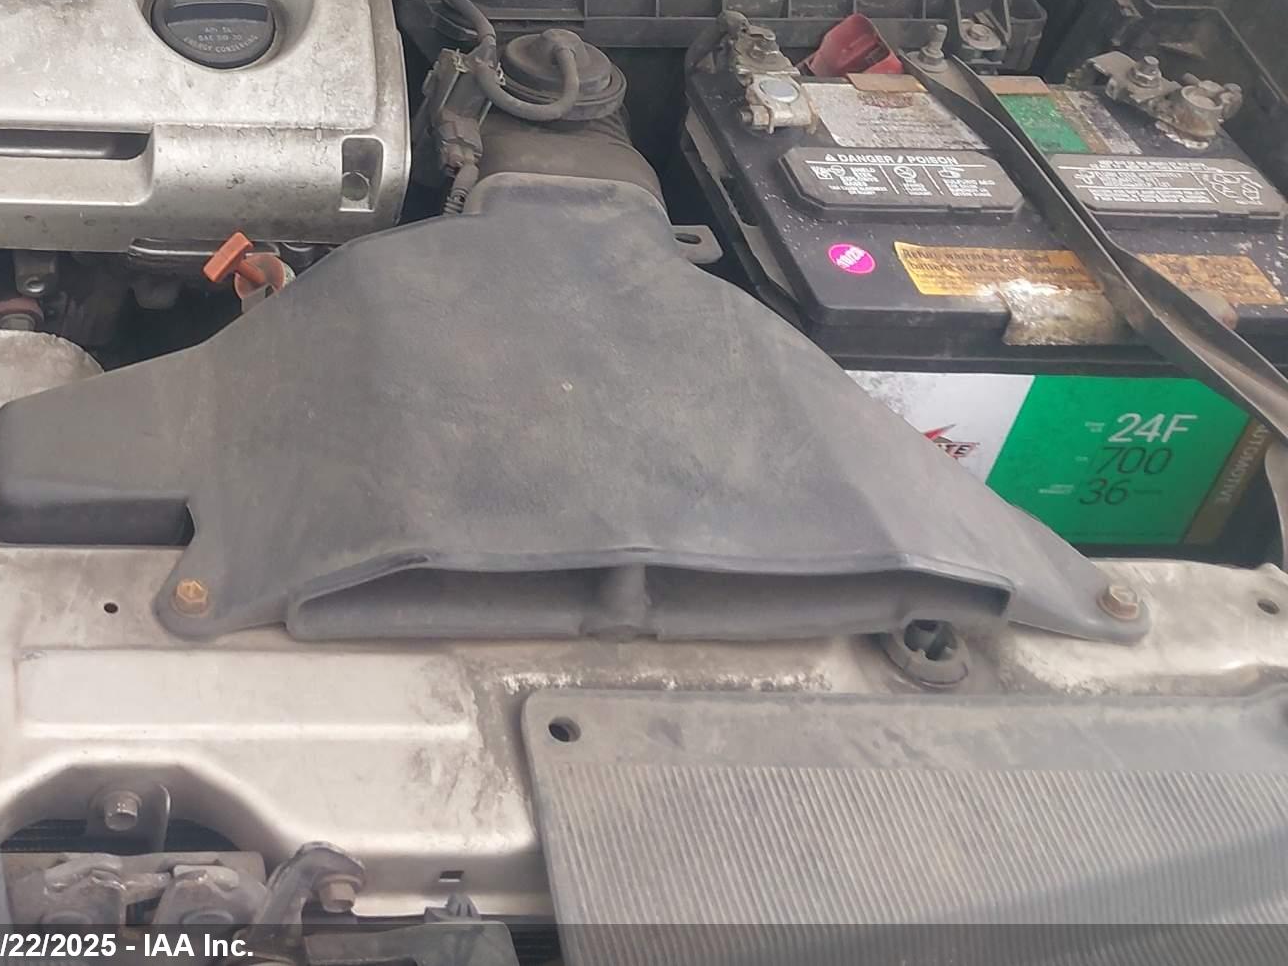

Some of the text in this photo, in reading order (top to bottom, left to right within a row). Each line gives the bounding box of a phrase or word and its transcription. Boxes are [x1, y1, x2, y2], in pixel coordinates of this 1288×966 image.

[836, 153, 895, 164] DANGER
[906, 155, 959, 165] POISON
[1107, 412, 1198, 444] 24F
[1095, 445, 1173, 475] 700
[1079, 476, 1131, 506] 36
